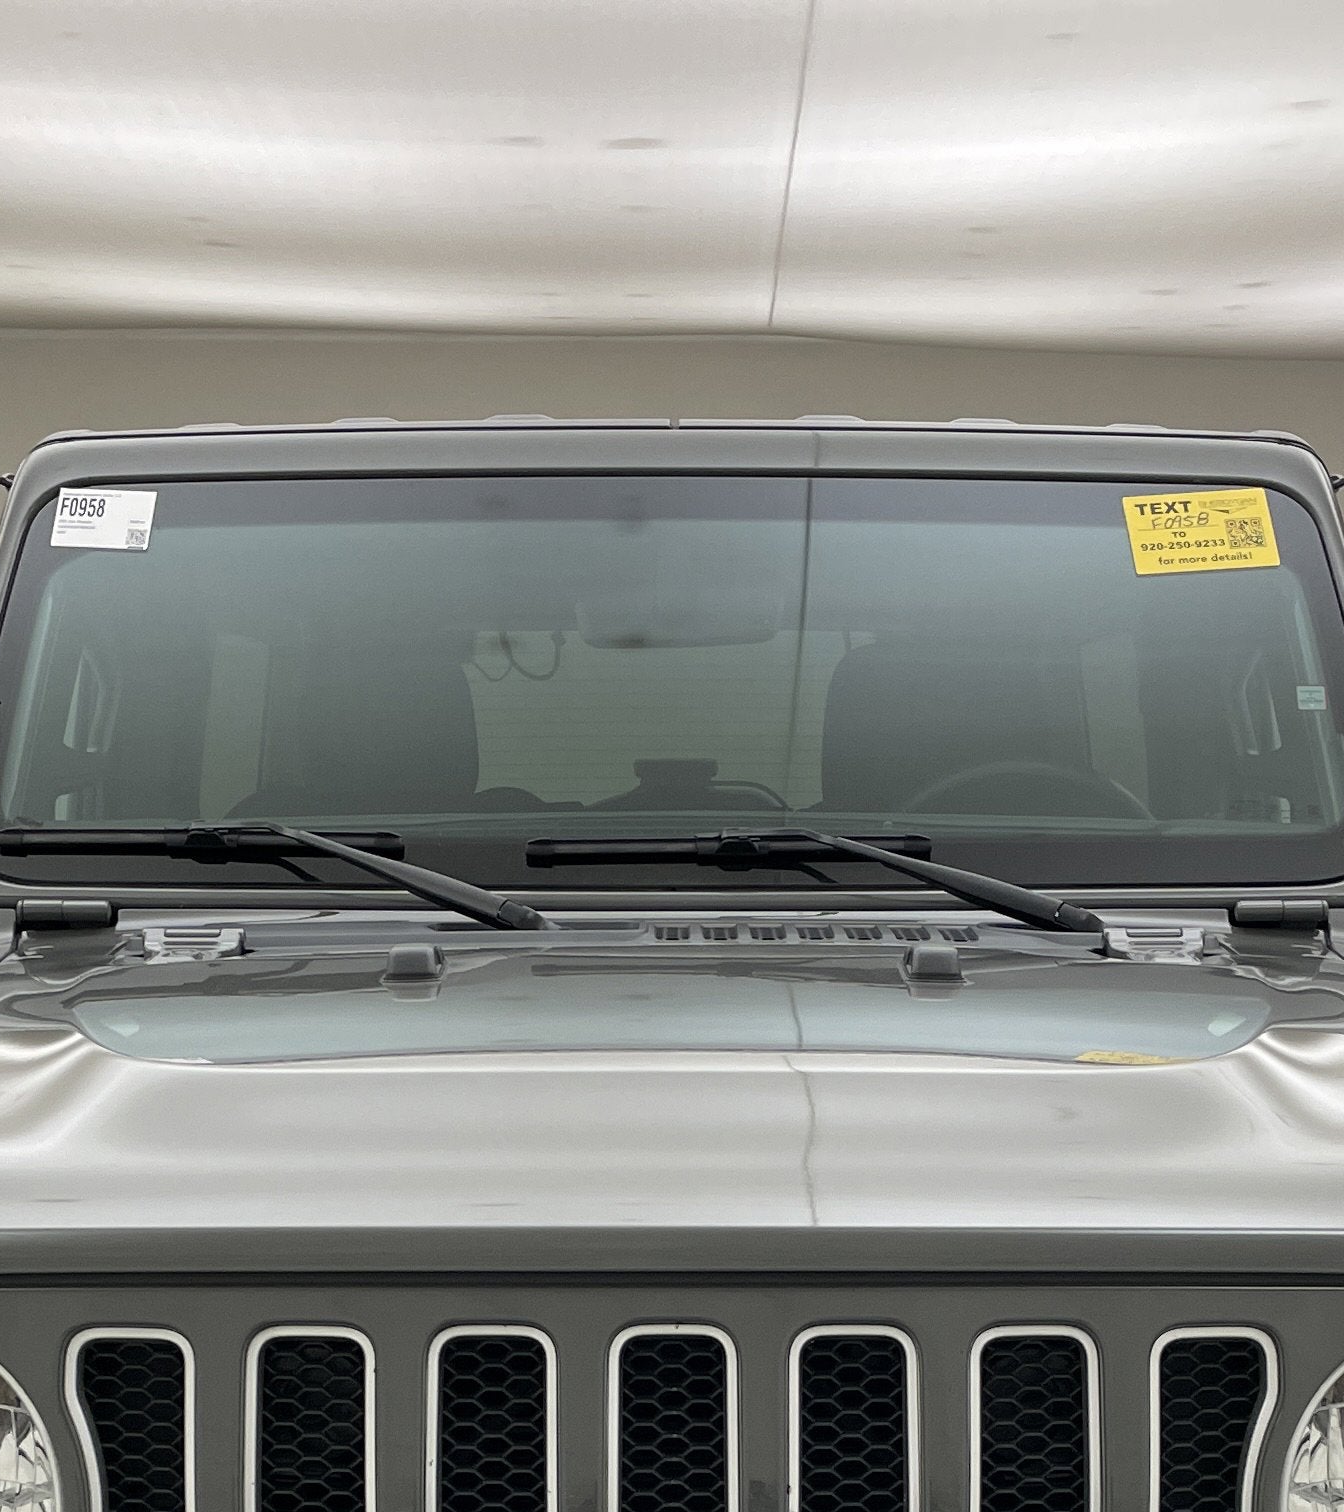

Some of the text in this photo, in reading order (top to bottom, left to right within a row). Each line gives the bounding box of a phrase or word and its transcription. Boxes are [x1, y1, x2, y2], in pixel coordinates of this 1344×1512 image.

[59, 497, 106, 518] F0958
[1134, 500, 1192, 516] TEXT
[1151, 511, 1210, 530] F0958
[1171, 531, 1187, 539] TO
[1140, 538, 1226, 552] 920-250-9233
[1158, 551, 1254, 566] for more details!
